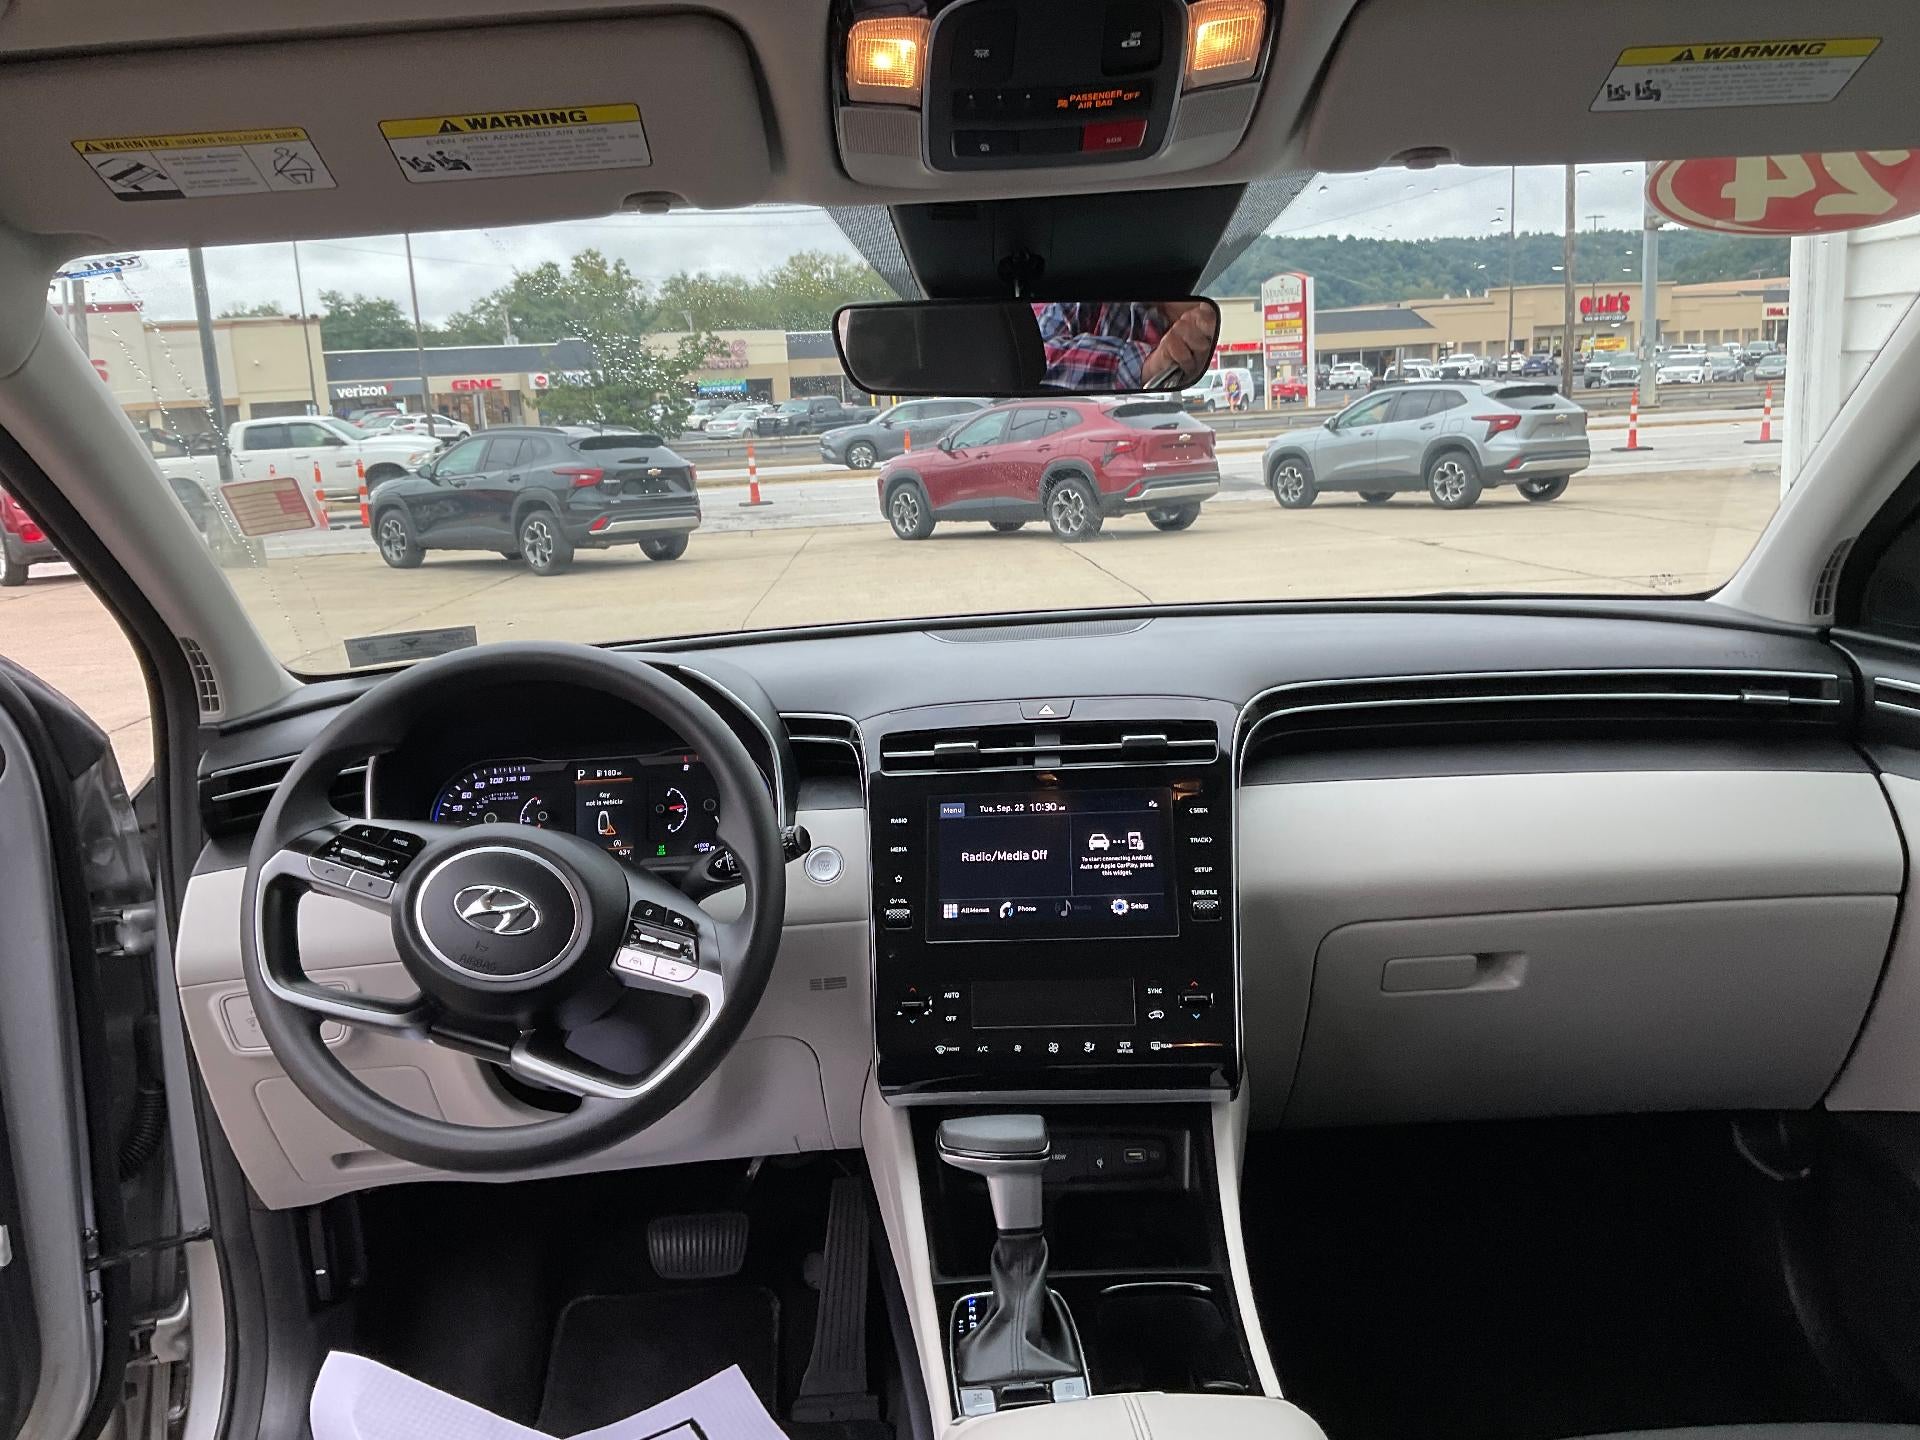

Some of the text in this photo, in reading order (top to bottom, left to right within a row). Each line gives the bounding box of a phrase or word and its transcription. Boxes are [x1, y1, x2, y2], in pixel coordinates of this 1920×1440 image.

[1703, 42, 1827, 60] WARNING
[1070, 90, 1122, 102] PASSENGER
[465, 109, 588, 130] WARNING
[102, 138, 169, 152] WARNING
[336, 384, 388, 399] verizon
[451, 378, 503, 392] GNC
[578, 770, 586, 780] P
[996, 805, 1013, 813] Sep.
[1029, 803, 1057, 812] 10:30
[962, 850, 1048, 862] Radio/Media Off
